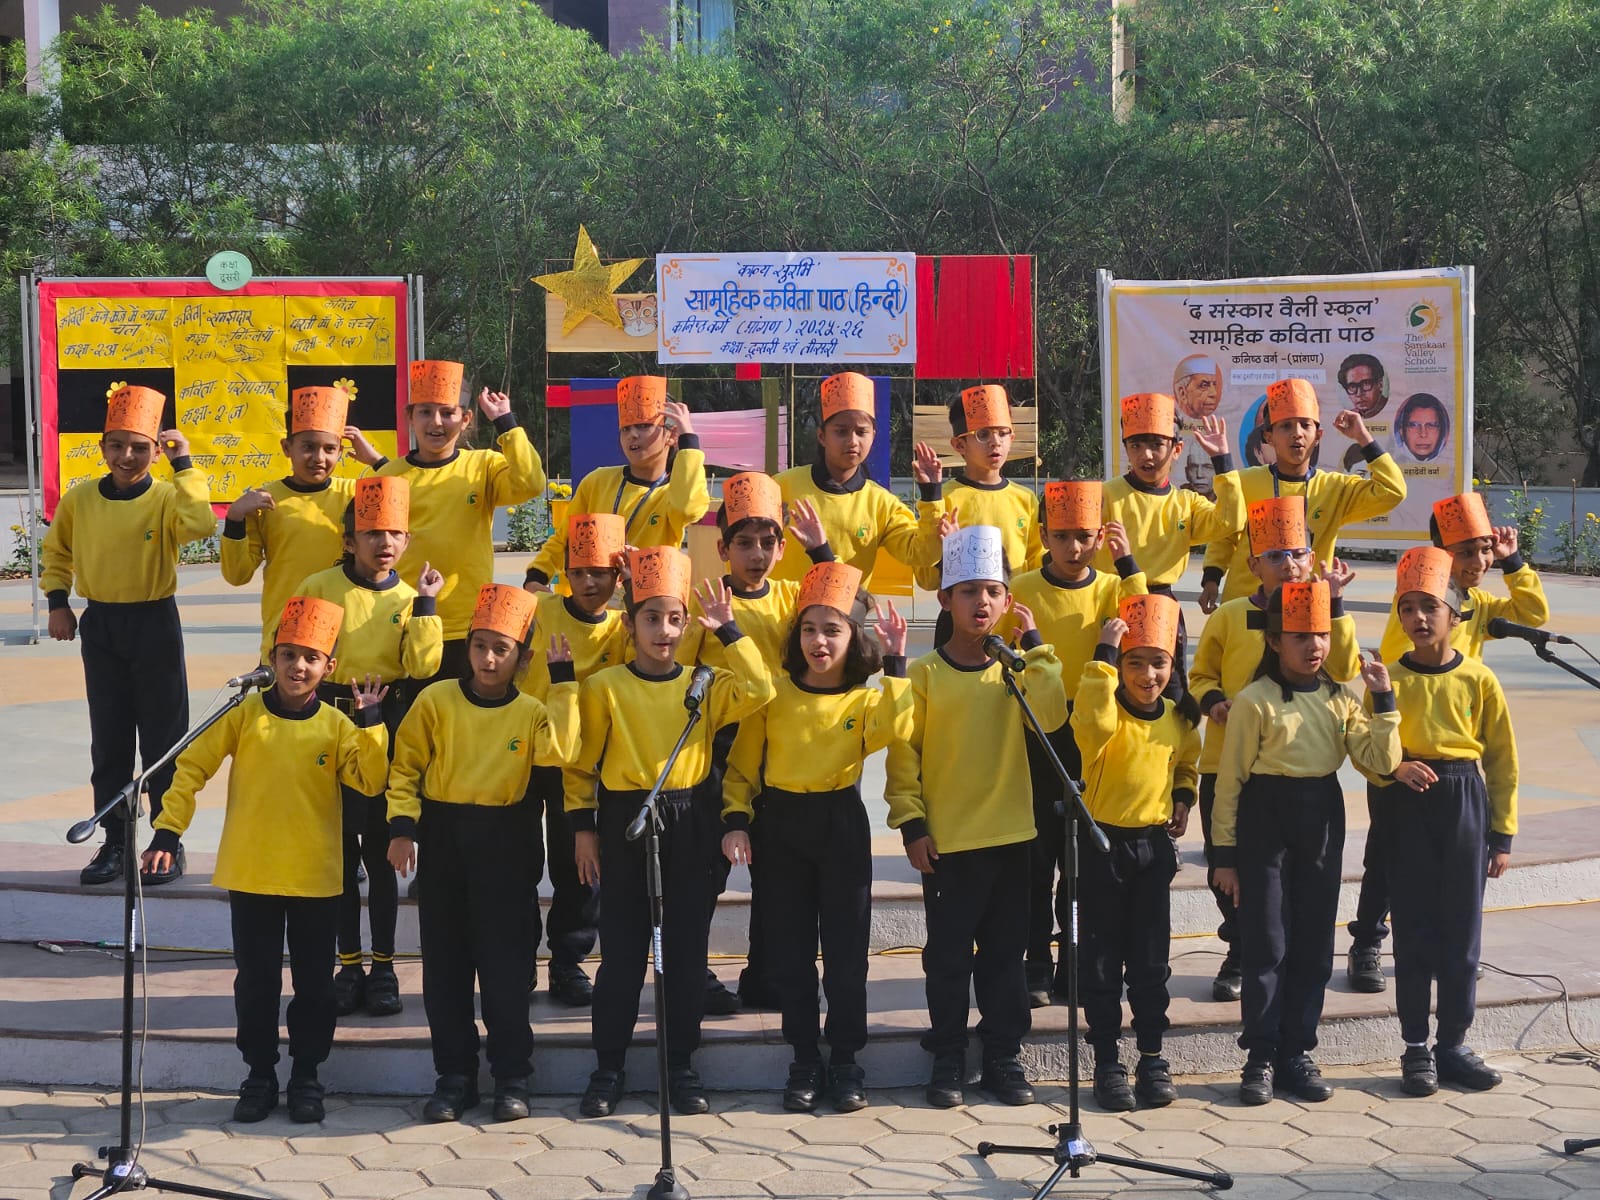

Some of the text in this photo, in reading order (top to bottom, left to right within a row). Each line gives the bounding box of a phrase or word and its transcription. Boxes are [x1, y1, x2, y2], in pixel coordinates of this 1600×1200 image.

[218, 270, 241, 284] दूसरी
[684, 279, 908, 318] सामूहिक कविता पाठ (हिन्दी)
[1208, 298, 1274, 319] संस्कार
[1279, 295, 1319, 318] वैली
[1189, 322, 1375, 351] सामूहिक कविता पाठ
[1404, 333, 1424, 342] The
[799, 338, 839, 358] तीसरी
[1404, 341, 1447, 350] Sanskaar
[1231, 352, 1262, 365] कनिष्ठ
[1262, 352, 1278, 364] वर्ग
[1405, 348, 1435, 358] Valley
[1404, 356, 1437, 366] School
[221, 453, 240, 467] का
